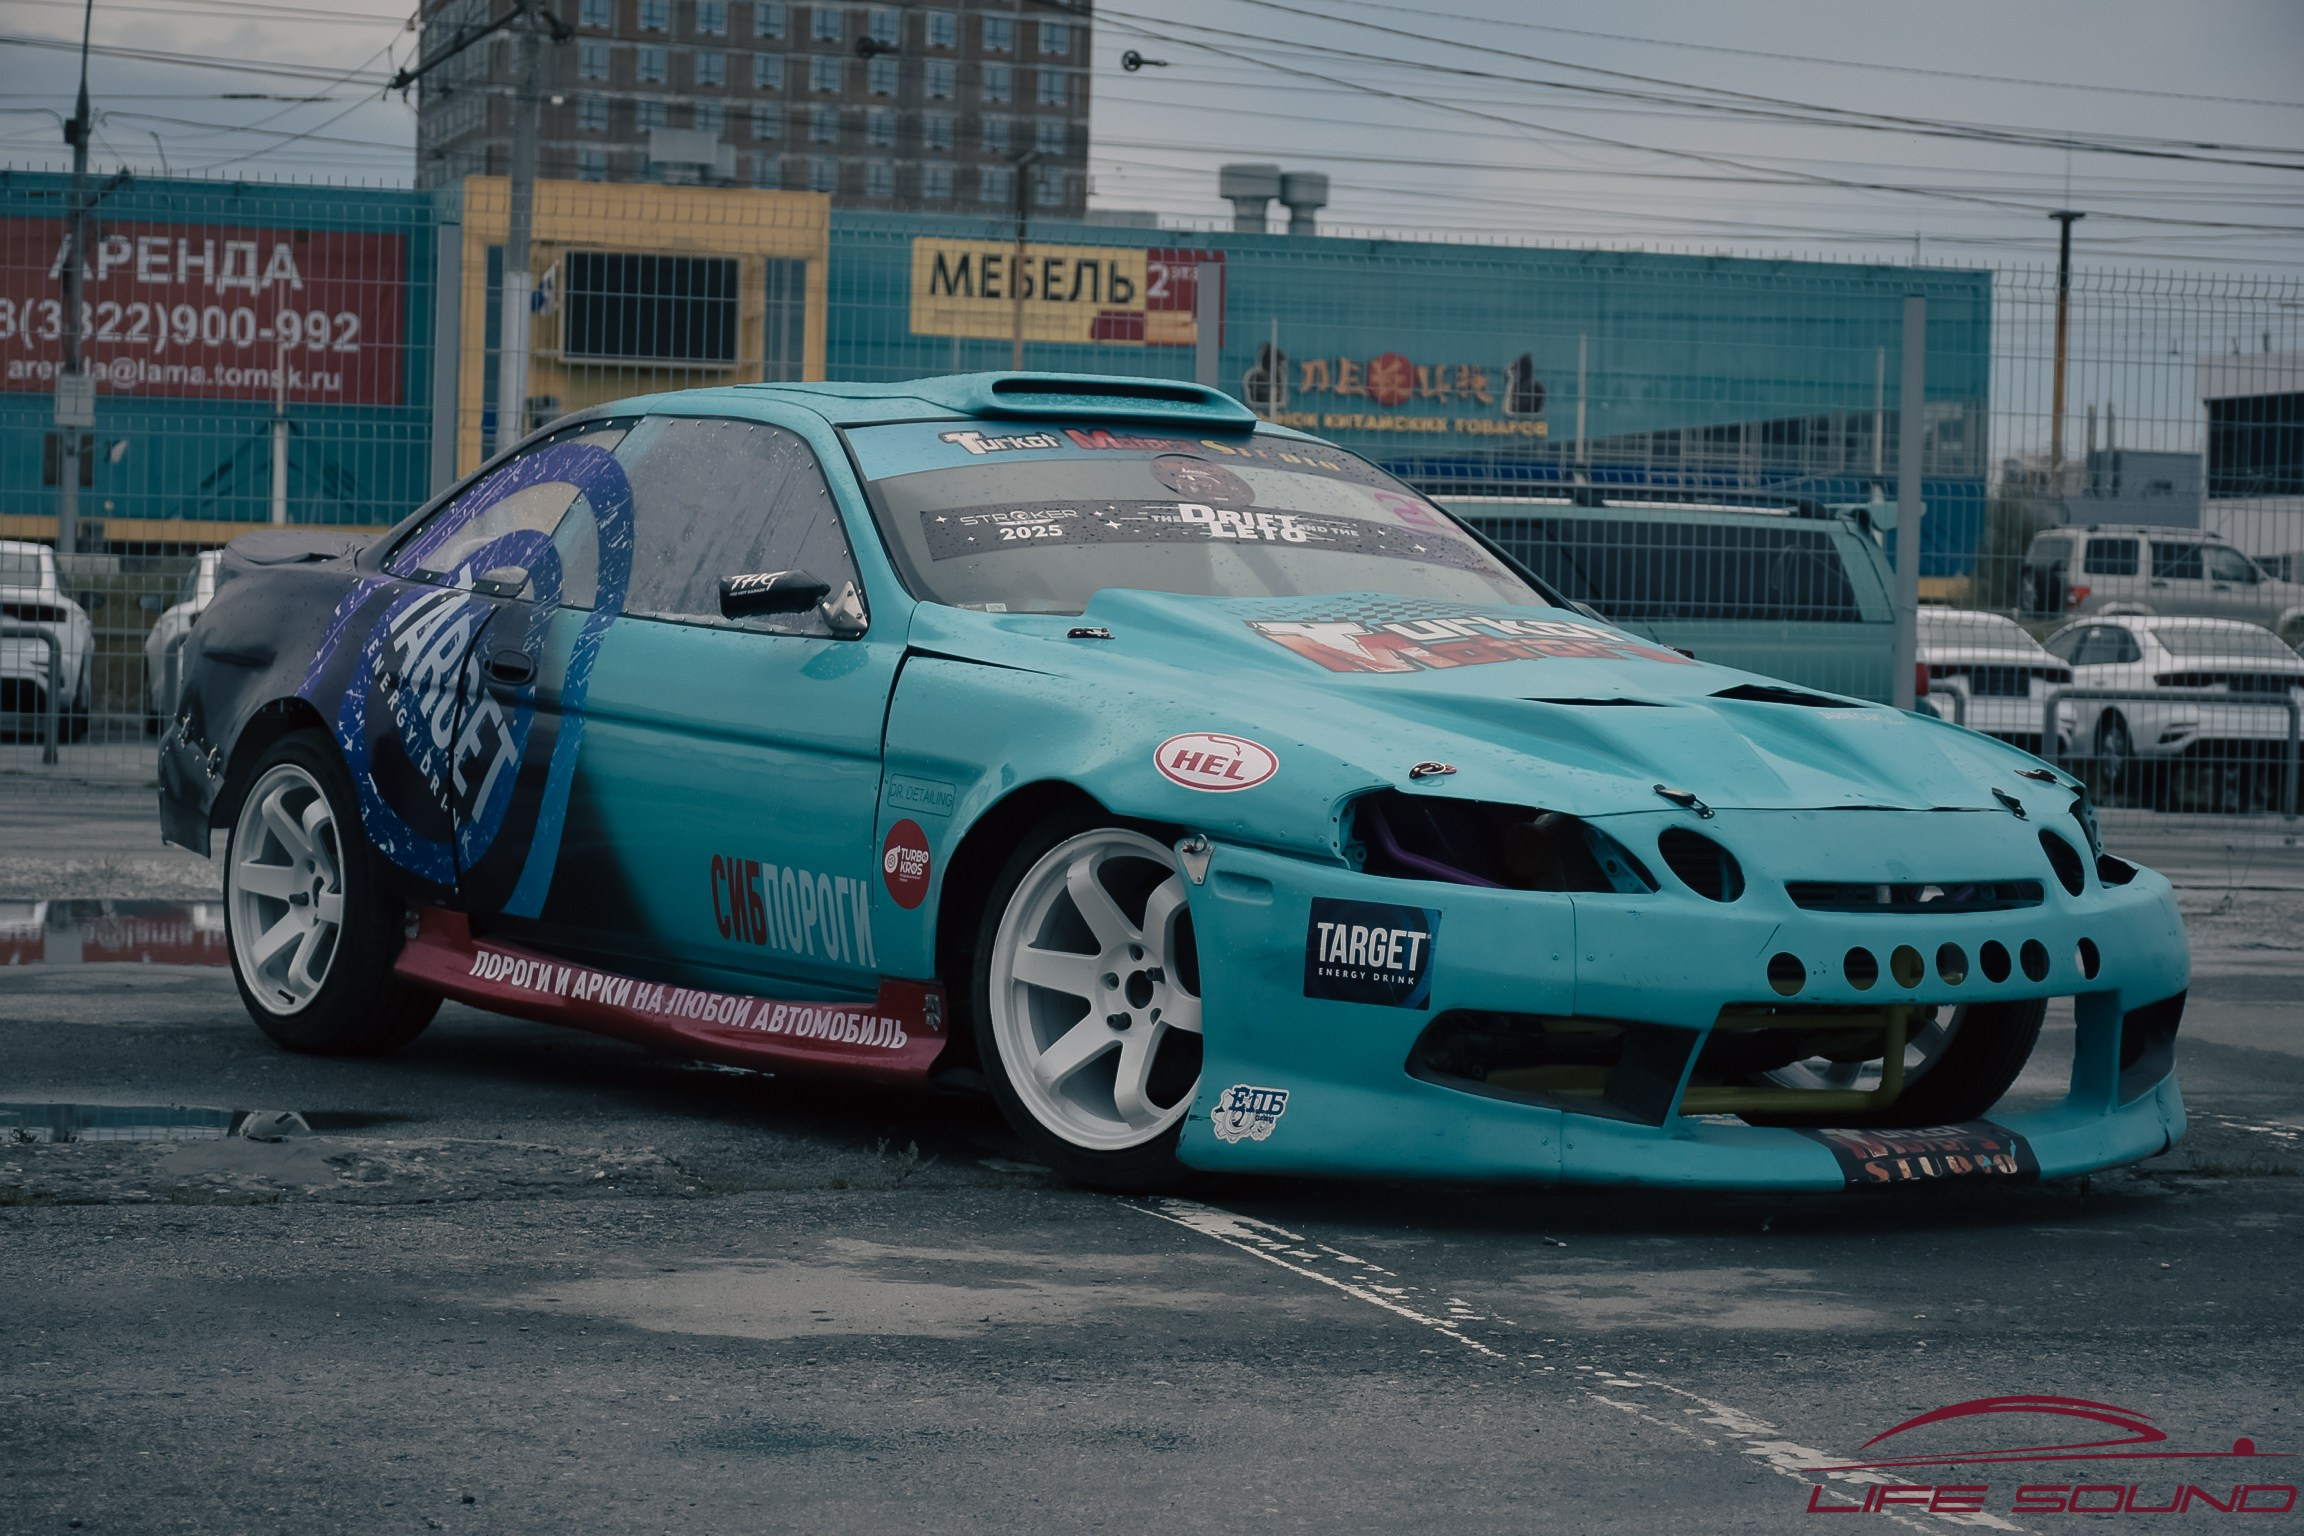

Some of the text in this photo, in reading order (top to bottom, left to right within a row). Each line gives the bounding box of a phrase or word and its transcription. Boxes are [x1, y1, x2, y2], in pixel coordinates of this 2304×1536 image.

[48, 233, 304, 297] АРЕНДА
[930, 250, 1136, 304] МЕБЕЛЬ
[1147, 262, 1170, 297] 2
[1324, 412, 1448, 432] КИТАЙСКИХ
[1151, 503, 1297, 529] THE DRIFT
[1000, 525, 1063, 541] 2025
[1209, 521, 1307, 543] LETO
[1331, 527, 1360, 537] THE
[731, 571, 787, 591] THG
[367, 638, 417, 743] ENERGY
[390, 562, 518, 824] TARGET
[1171, 749, 1245, 781] HEL
[906, 785, 953, 808] DETAILING
[900, 861, 923, 876] KROS
[901, 847, 929, 864] TURBO
[711, 853, 877, 969] СИБПОРОГИ
[1317, 922, 1427, 972] TARGET
[1318, 967, 1415, 985] ENERGY DRINK
[469, 950, 908, 1049] ПОРОГИ И АРКИ НА ЛЮБОЙ АВТОМОБИЛЬ
